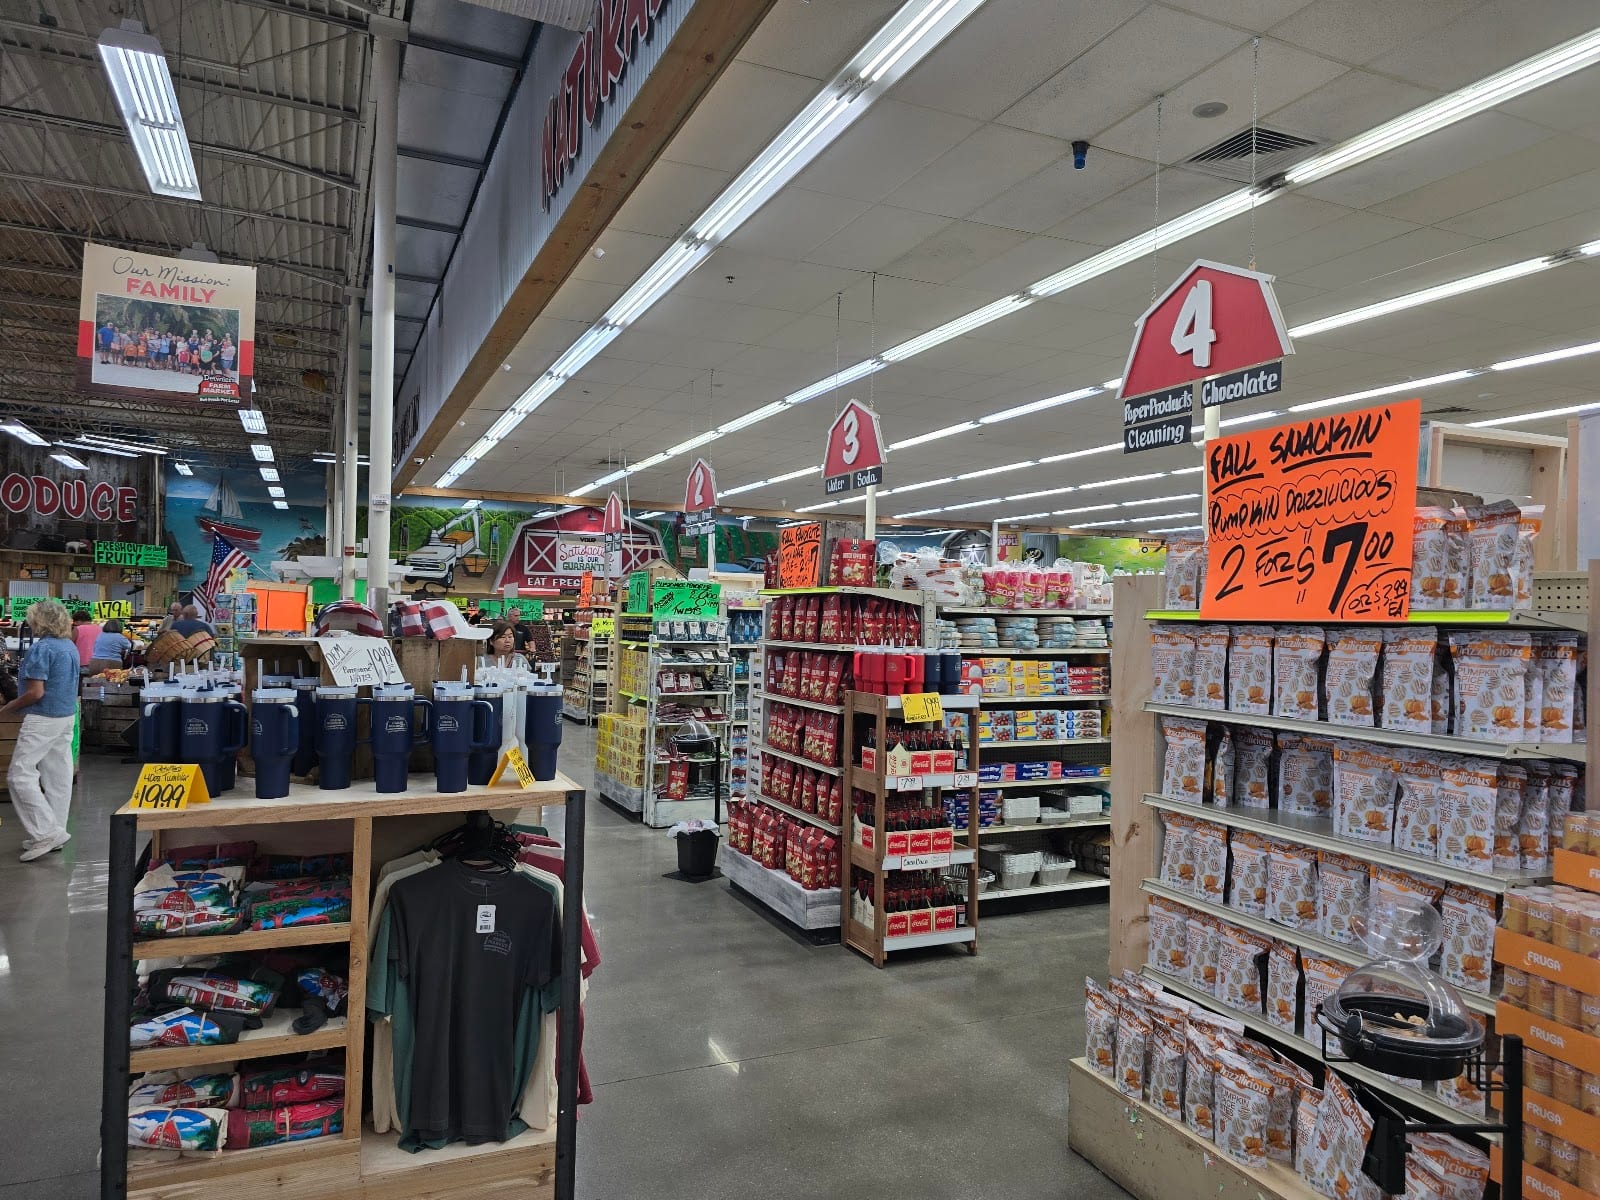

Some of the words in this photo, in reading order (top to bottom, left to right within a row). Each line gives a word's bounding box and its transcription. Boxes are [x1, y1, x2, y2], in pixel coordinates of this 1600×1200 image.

[113, 256, 154, 276] Our
[126, 277, 217, 304] FAMILY
[1171, 279, 1217, 368] 4
[202, 387, 237, 395] MARKET
[1202, 371, 1278, 405] Chocolate
[1149, 391, 1193, 418] Products
[842, 409, 860, 465] 3
[1128, 422, 1184, 448] Cleaning
[1210, 438, 1258, 484] FALL
[695, 465, 705, 506] 2
[856, 470, 878, 488] Soda
[0, 472, 137, 523] ODUCE
[96, 540, 127, 553] FRESH
[126, 542, 143, 553] CUT
[96, 550, 143, 566] FRUIT!
[527, 576, 548, 586] EAT
[1215, 544, 1247, 602] 2
[1527, 950, 1562, 972] FRUGA
[1529, 1025, 1566, 1049] FRUGA
[1526, 1101, 1563, 1126] FRUGA
[1525, 1175, 1561, 1199] FRUGA
